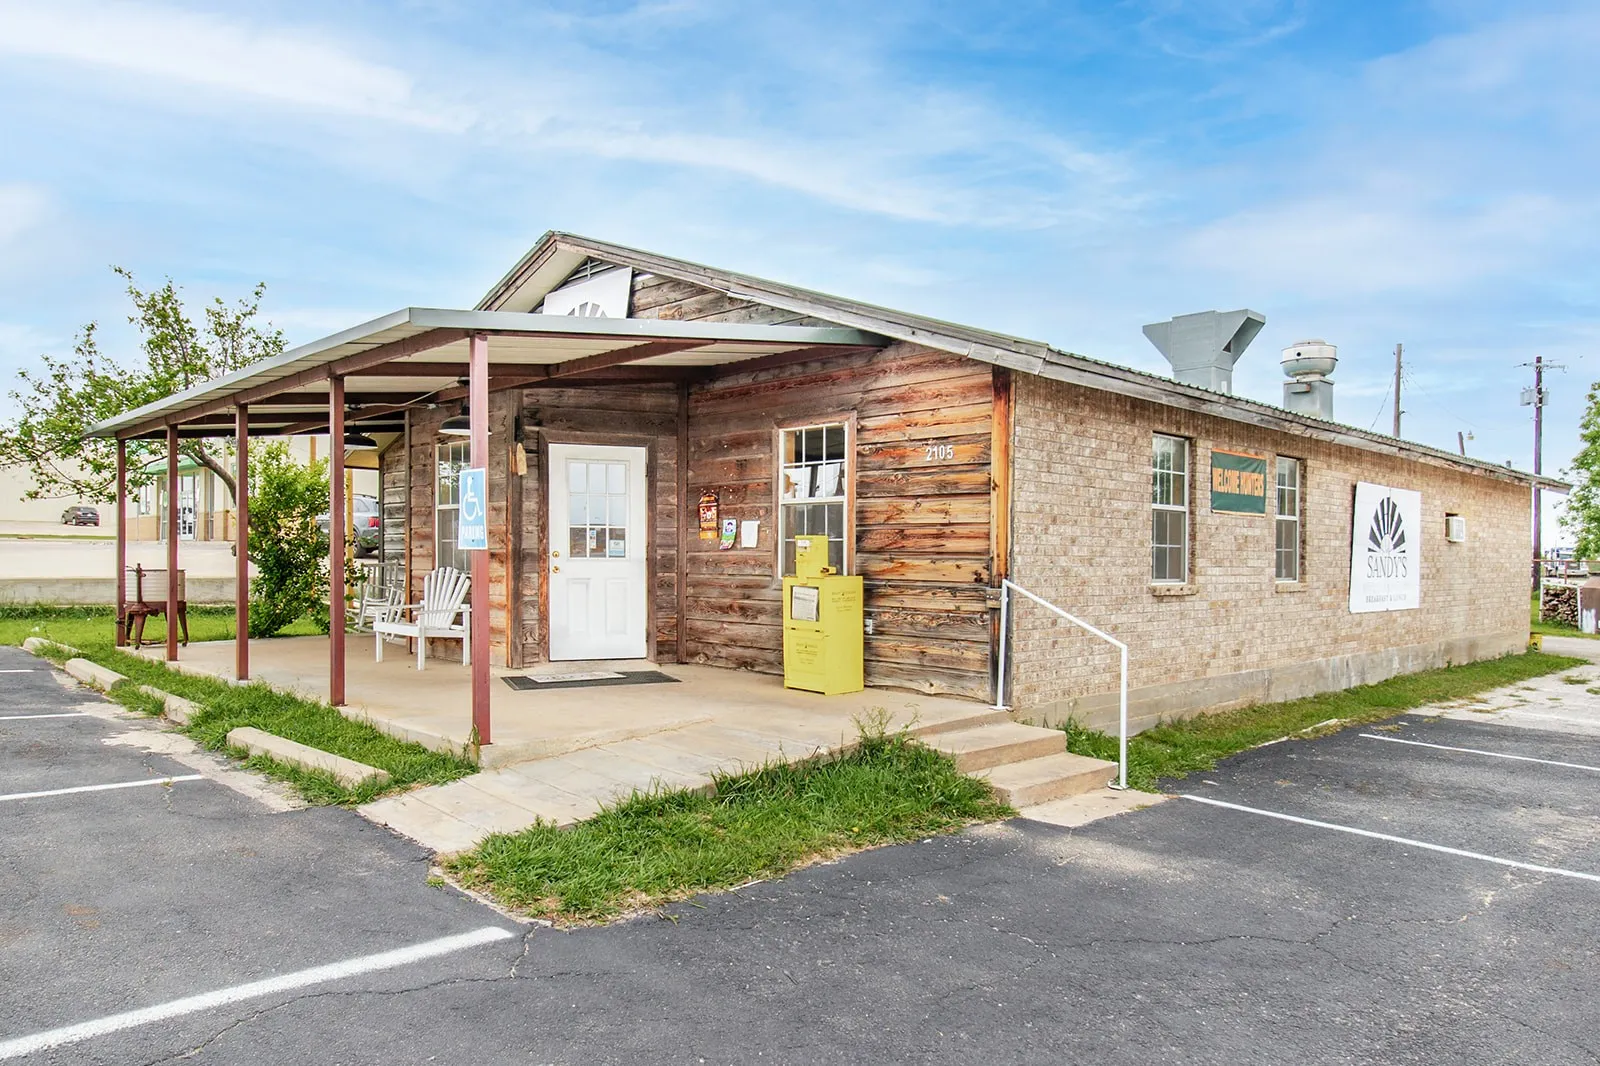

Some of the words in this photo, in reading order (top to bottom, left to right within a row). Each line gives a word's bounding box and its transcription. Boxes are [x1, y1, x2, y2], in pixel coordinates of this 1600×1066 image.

[926, 445, 953, 461] 2105
[1212, 467, 1239, 494] WELCOME
[1367, 555, 1408, 579] SANDY'S
